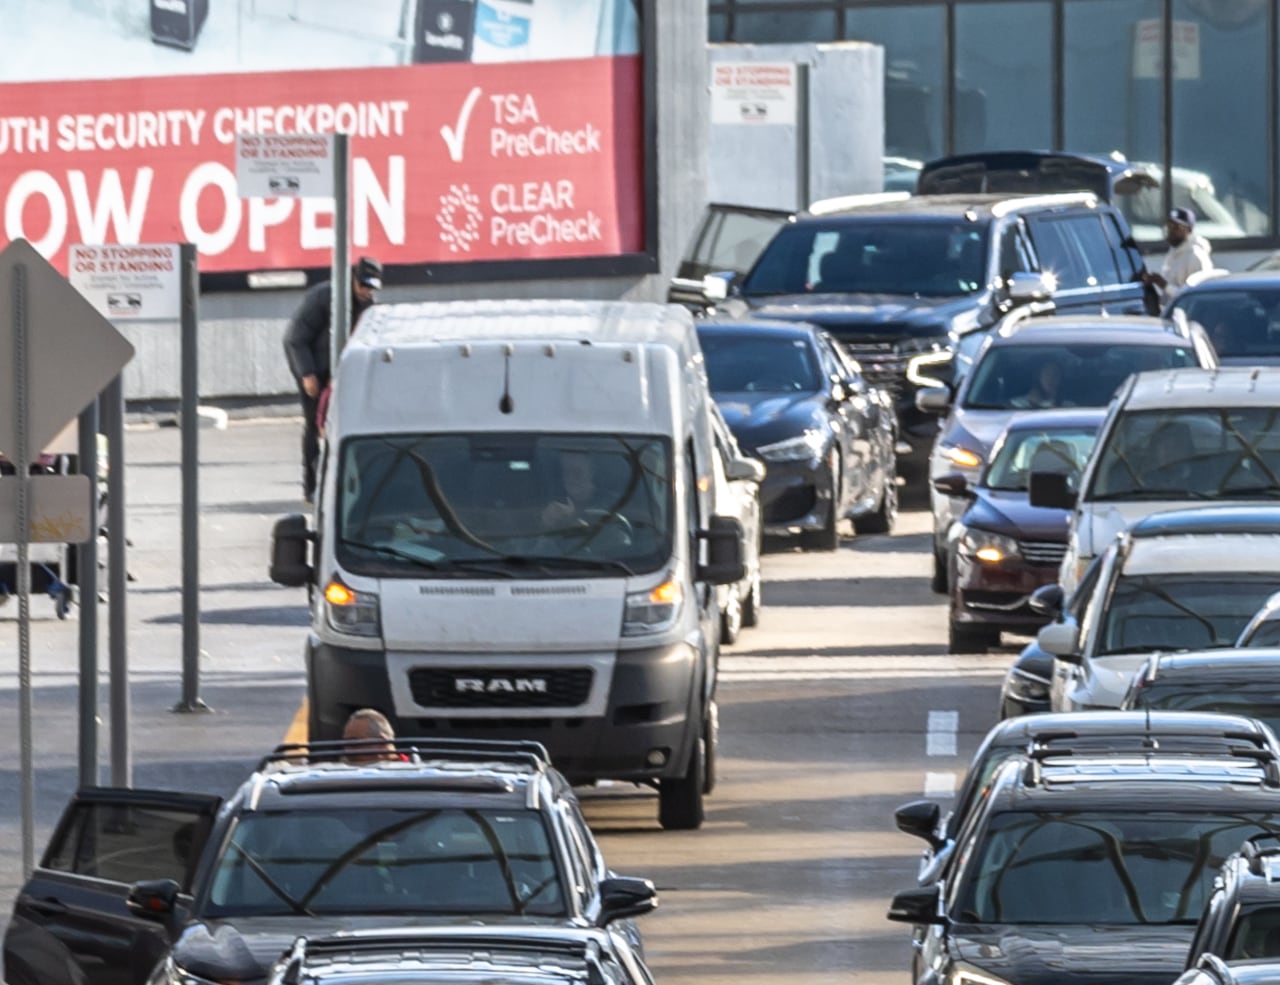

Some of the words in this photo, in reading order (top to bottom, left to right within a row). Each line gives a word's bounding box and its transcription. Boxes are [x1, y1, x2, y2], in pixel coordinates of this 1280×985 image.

[490, 93, 540, 125] TSA
[57, 108, 206, 152] SECURITY
[490, 122, 602, 158] PreCheck
[490, 179, 575, 214] CLEAR
[490, 210, 602, 246] PreCheck
[75, 248, 98, 259] NO
[101, 247, 173, 259] STOPPING
[75, 261, 97, 273] OR
[100, 261, 174, 273] STANDING
[455, 679, 547, 693] RAM
